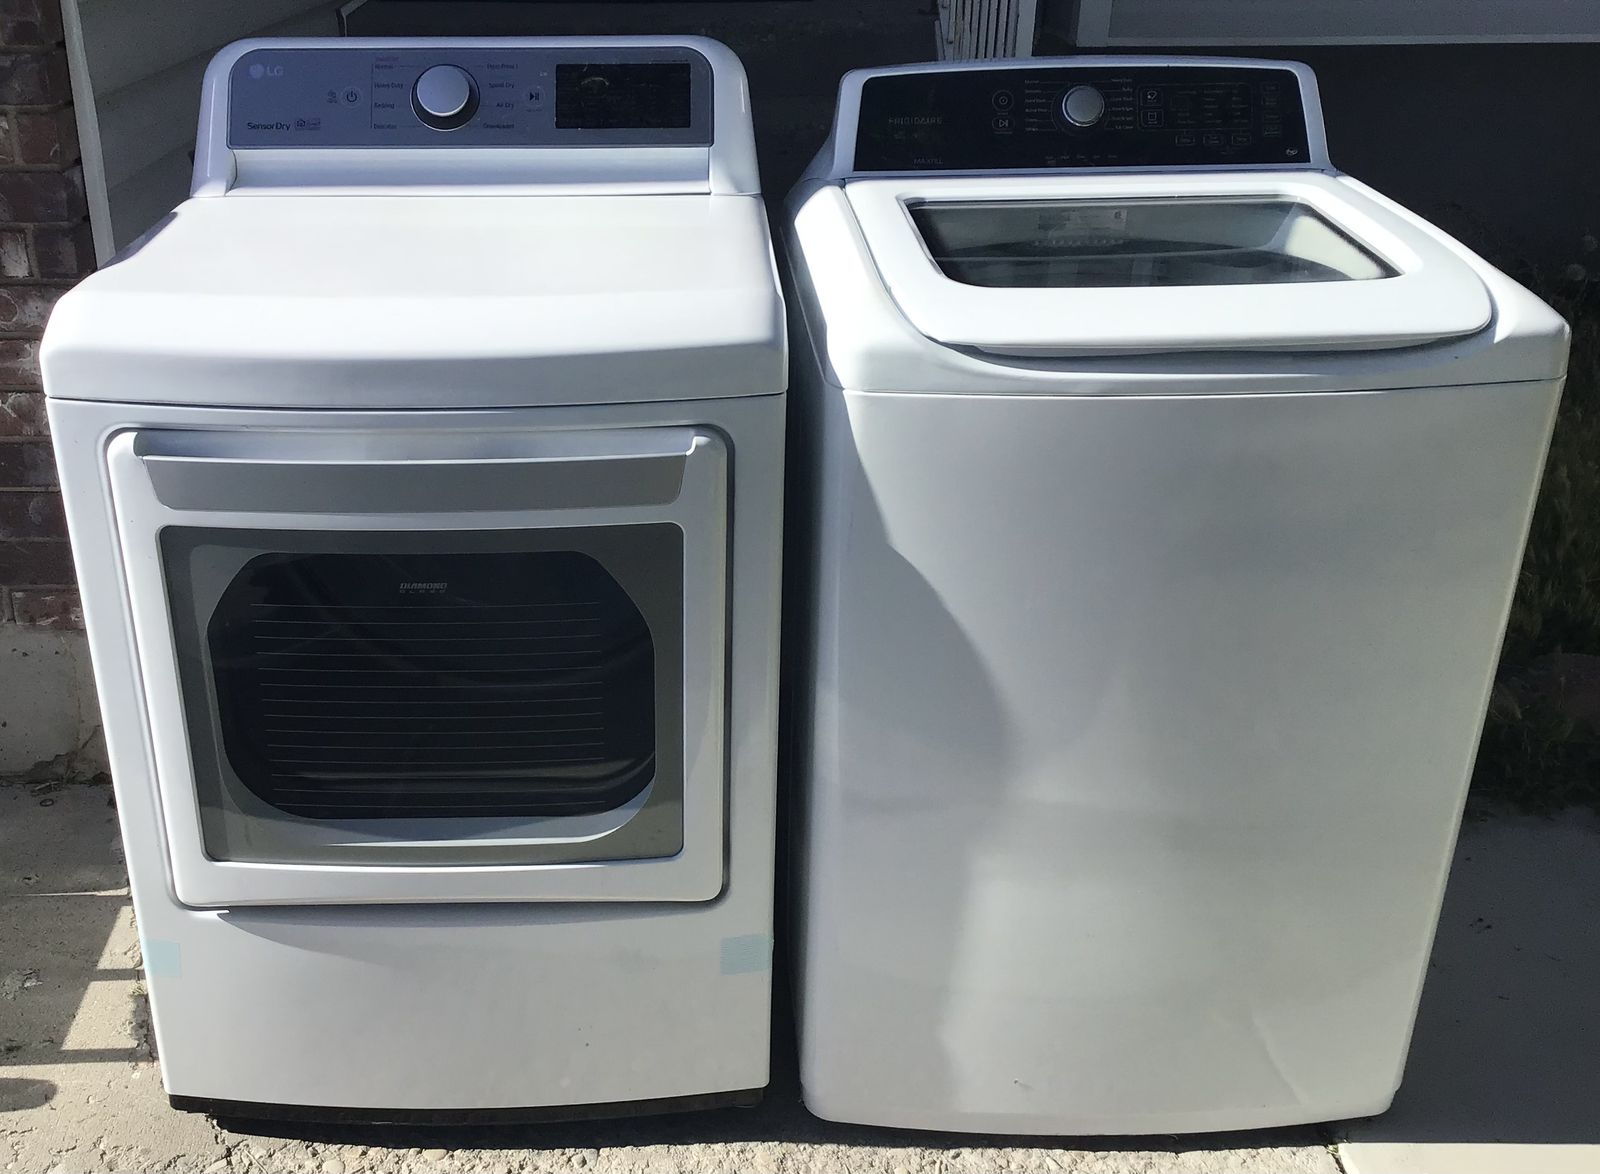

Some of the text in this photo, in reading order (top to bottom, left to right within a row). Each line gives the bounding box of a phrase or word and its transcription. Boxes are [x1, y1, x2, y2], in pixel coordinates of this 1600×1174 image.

[266, 65, 284, 77] LG
[247, 121, 291, 132] Sensor Dry
[399, 582, 448, 590] DIAMOND
